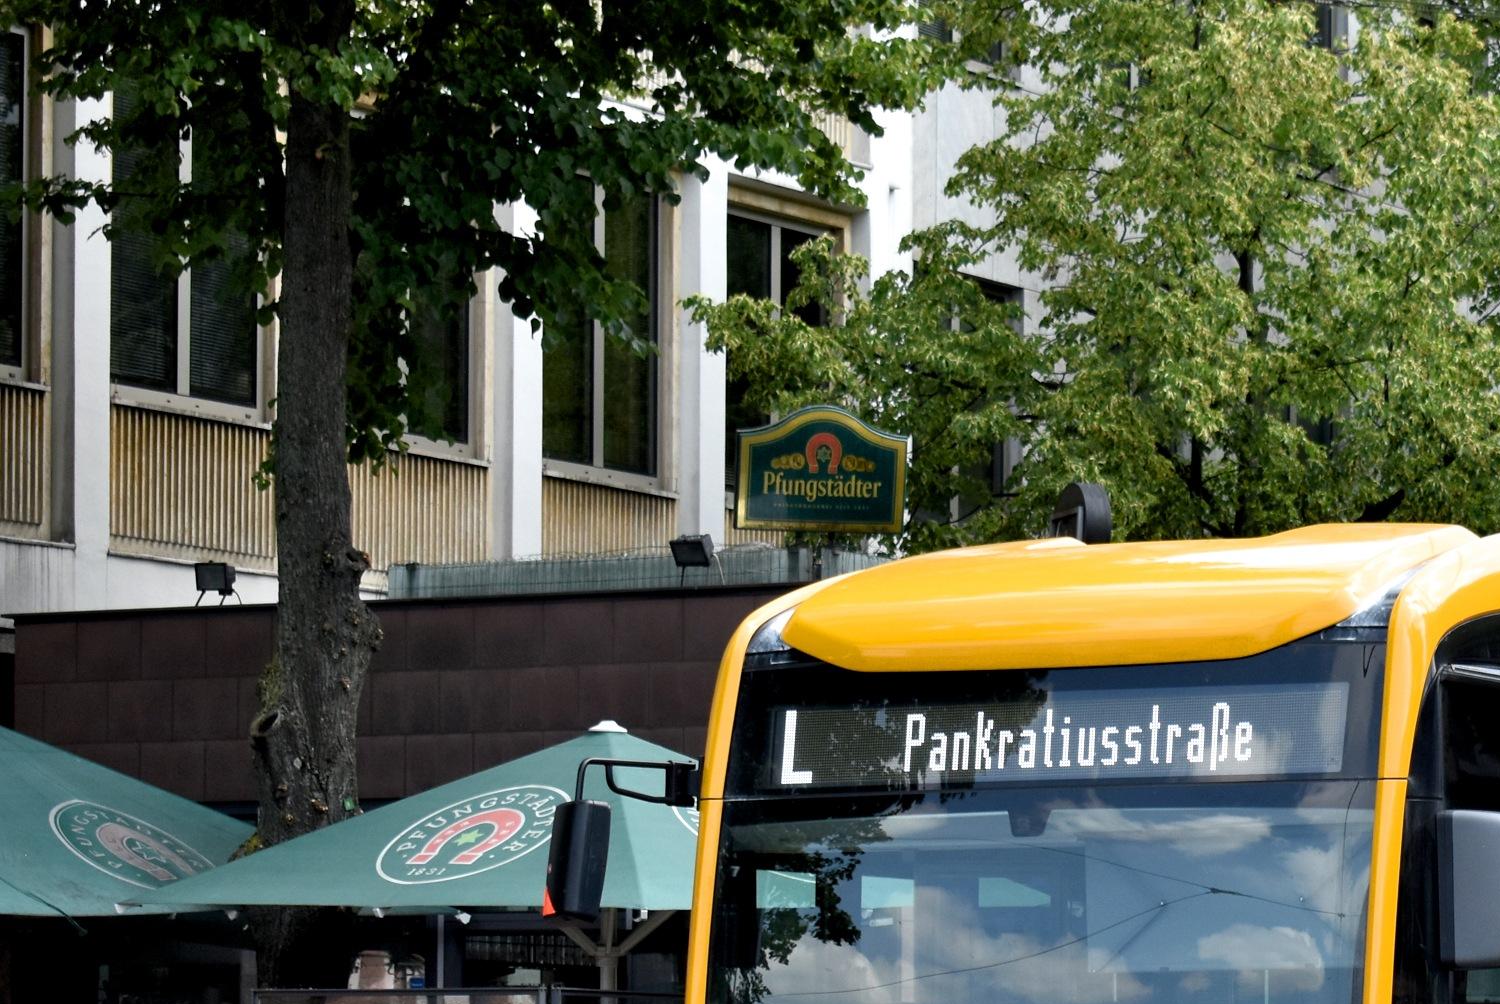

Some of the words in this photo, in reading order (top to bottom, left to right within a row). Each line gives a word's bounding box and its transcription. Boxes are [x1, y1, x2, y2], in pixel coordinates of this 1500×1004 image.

[763, 471, 881, 502] Pfungstädter
[780, 709, 812, 784] L
[903, 702, 1253, 771] Pankratiusstraße
